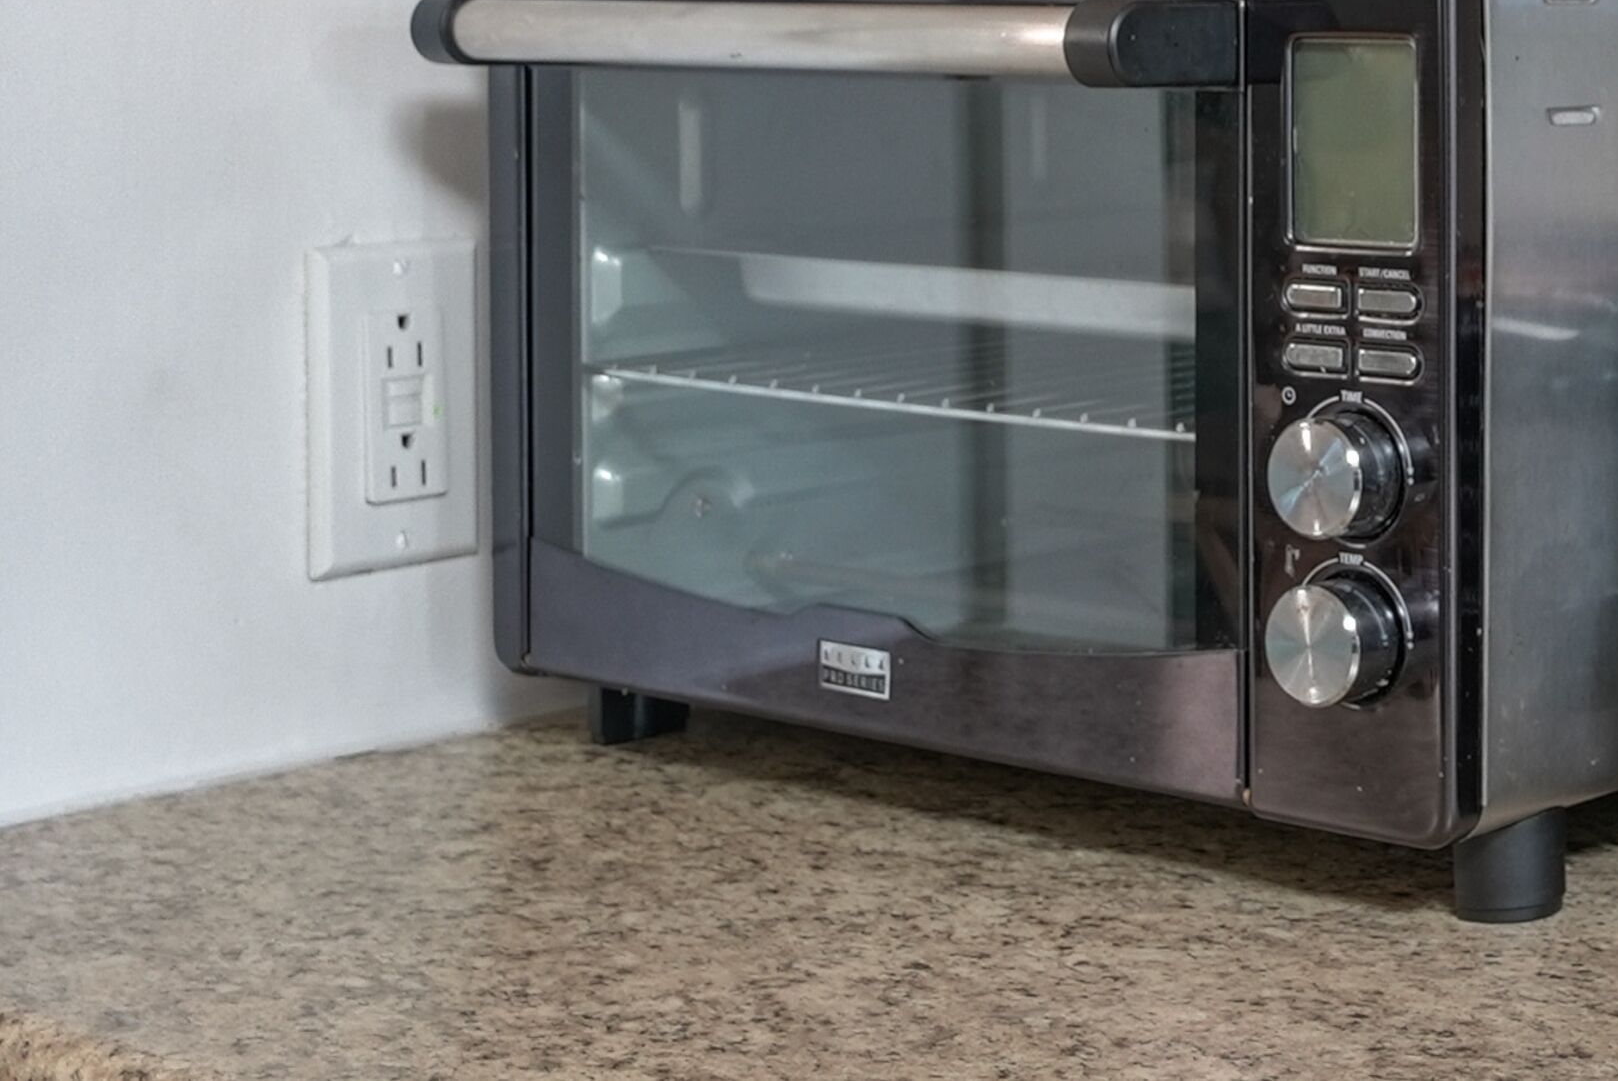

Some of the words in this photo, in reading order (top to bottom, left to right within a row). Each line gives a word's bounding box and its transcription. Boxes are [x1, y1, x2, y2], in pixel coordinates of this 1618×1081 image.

[1302, 264, 1337, 276] FUNCTION
[1358, 267, 1411, 280] START/CANCEL
[1301, 323, 1322, 334] LITTLE
[1324, 325, 1346, 335] EXTRA
[1363, 328, 1407, 340] CONVECTION
[1340, 390, 1363, 404] TIME
[1339, 552, 1364, 566] TEMP
